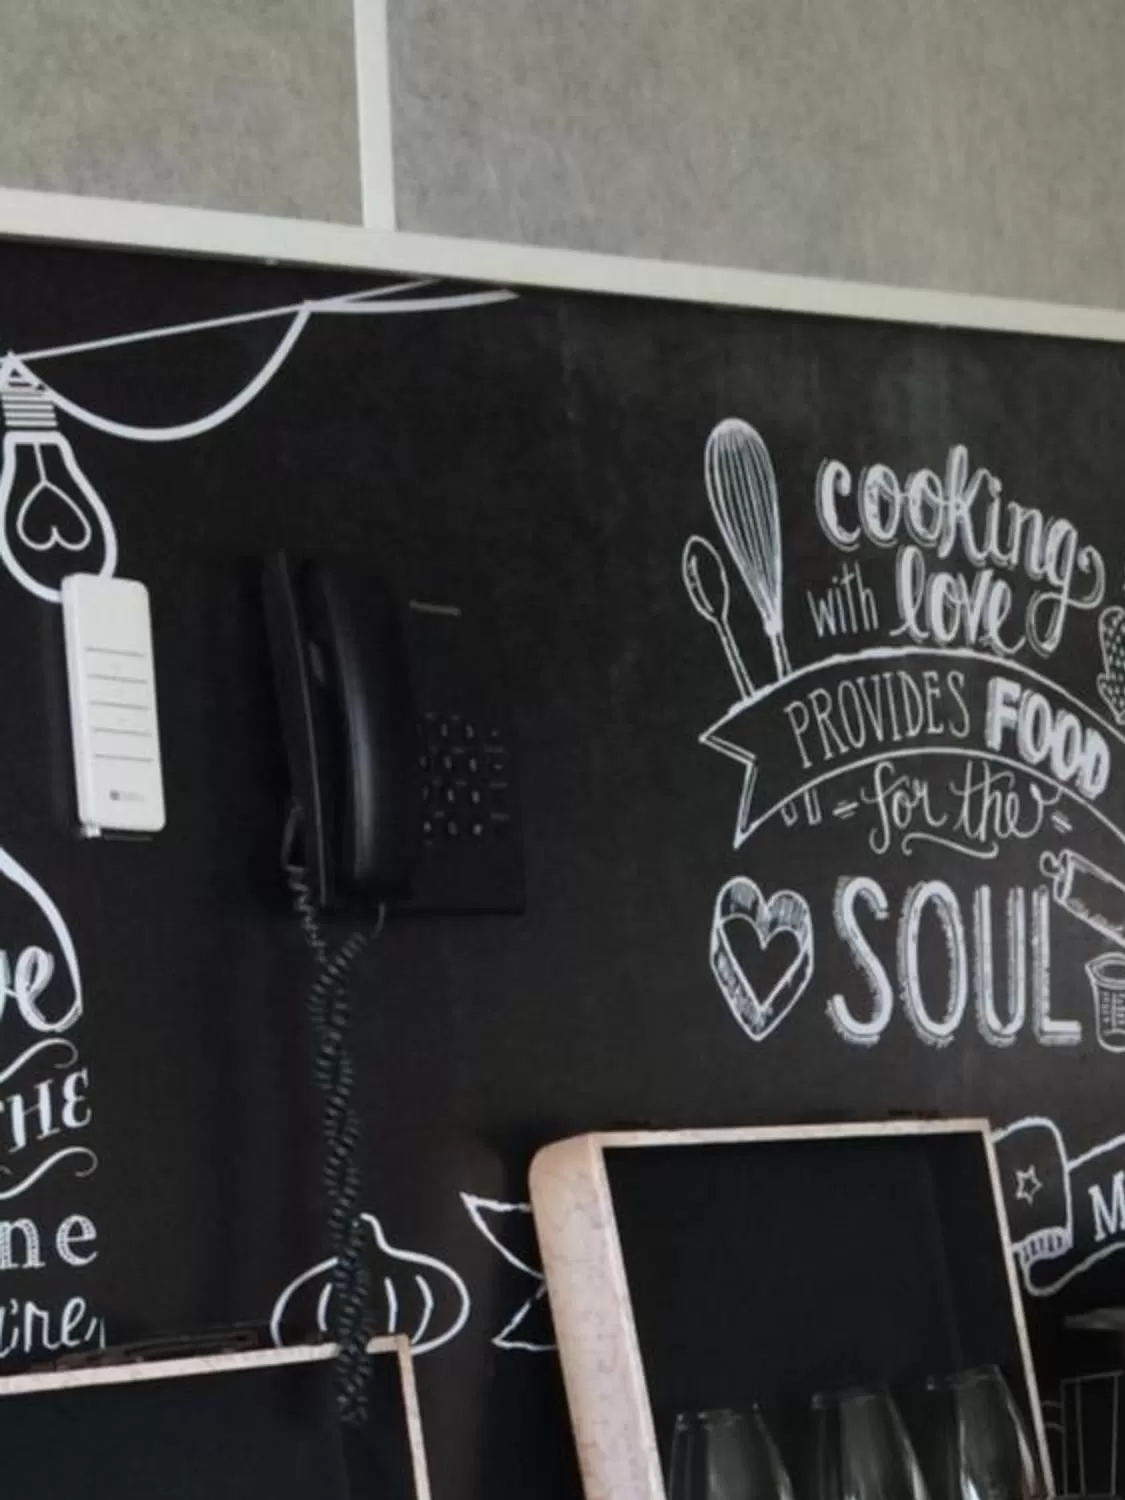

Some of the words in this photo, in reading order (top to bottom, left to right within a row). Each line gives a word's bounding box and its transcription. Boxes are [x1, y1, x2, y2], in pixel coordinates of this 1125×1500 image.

[807, 561, 879, 637] with
[890, 547, 1024, 656] love
[815, 444, 1105, 656] cooking
[783, 670, 971, 769] PROVIDES
[982, 676, 1110, 801] FOOD
[860, 762, 947, 853] for
[950, 760, 1060, 842] the
[828, 875, 1082, 1047] SOUL
